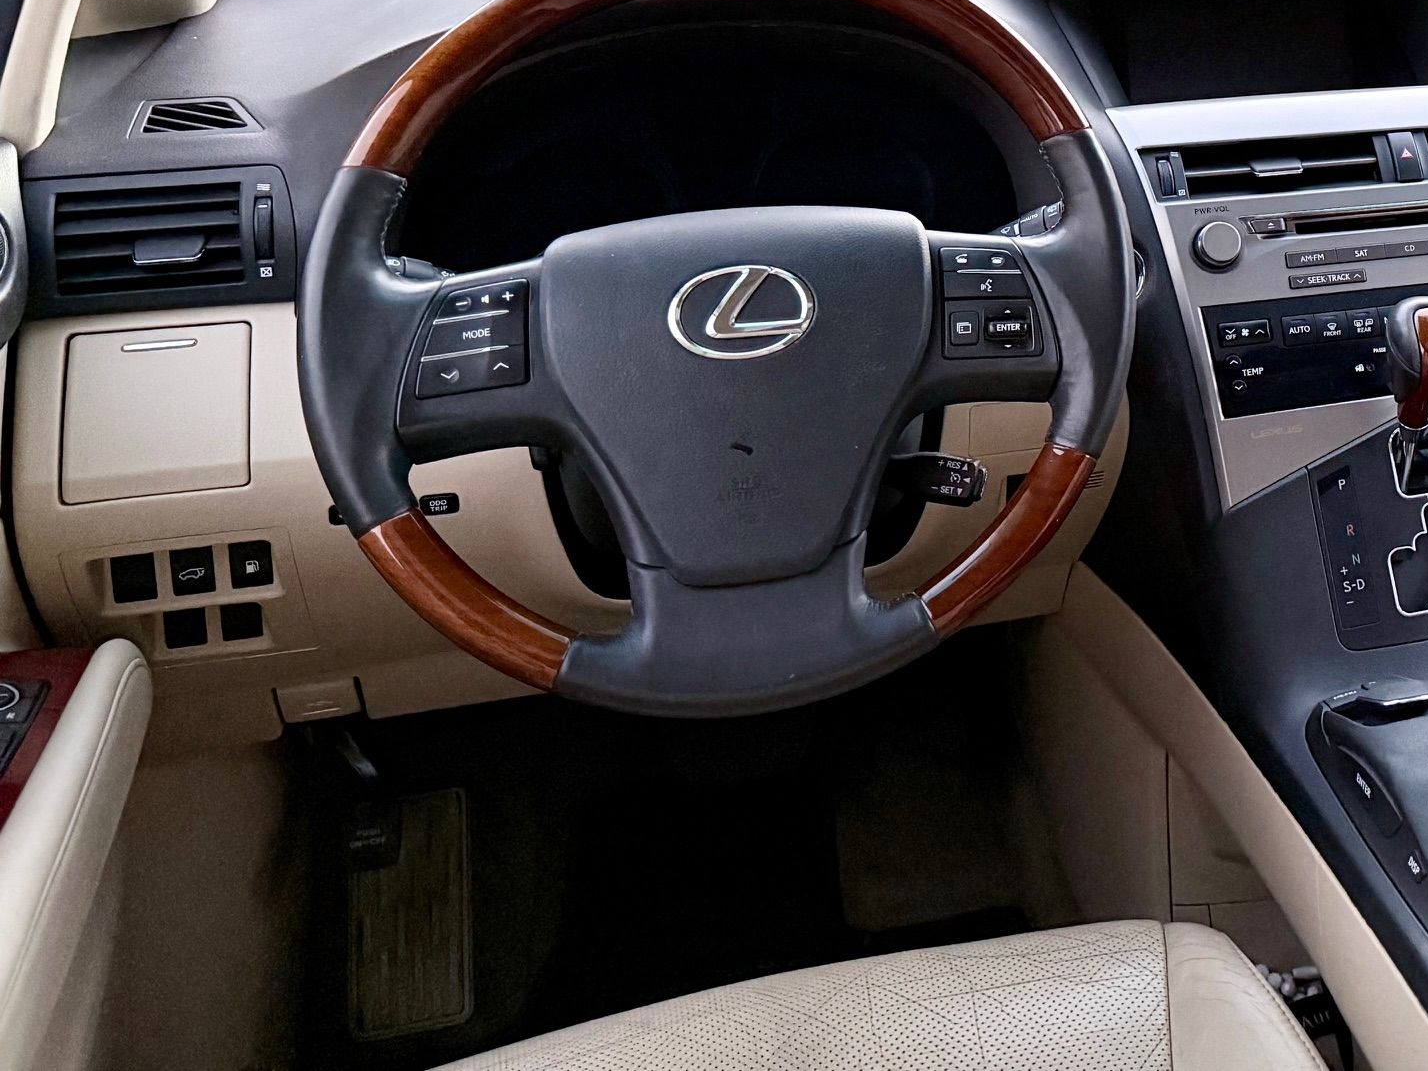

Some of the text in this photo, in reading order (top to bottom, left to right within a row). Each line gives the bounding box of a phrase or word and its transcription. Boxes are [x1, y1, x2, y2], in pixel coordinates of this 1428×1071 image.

[1354, 249, 1368, 258] SAT
[996, 322, 1021, 333] ENTER
[1288, 325, 1311, 335] AUTO
[1357, 326, 1372, 334] REAR
[461, 327, 492, 341] MODE
[1225, 333, 1237, 341] OFF
[1323, 329, 1342, 337] FRONT
[1241, 367, 1264, 377] TEMP
[946, 459, 962, 470] RES
[1338, 478, 1347, 491] P
[940, 485, 955, 495] SET
[429, 499, 447, 507] ODO
[1346, 524, 1356, 537] R
[1351, 553, 1361, 566] N
[1355, 772, 1372, 800] ENTER
[1407, 855, 1421, 875] DISP
